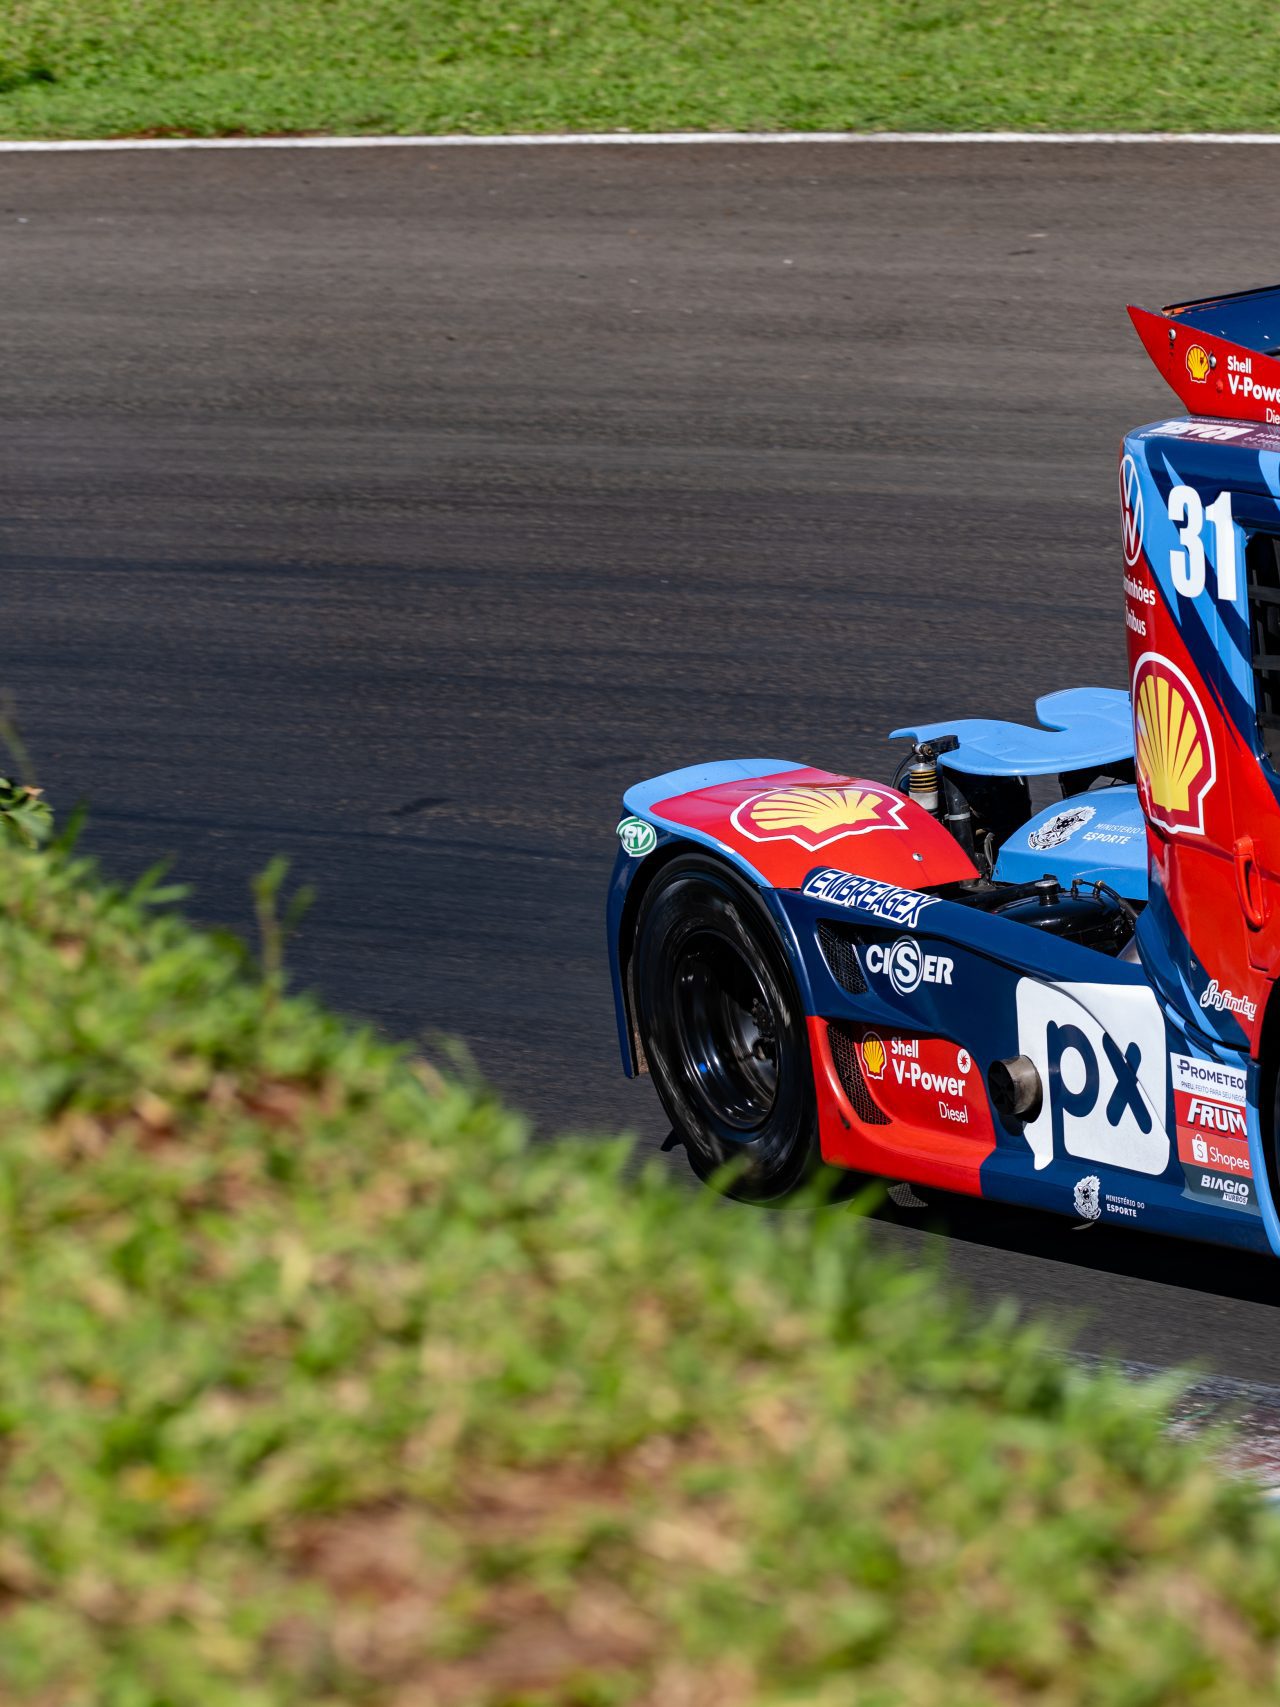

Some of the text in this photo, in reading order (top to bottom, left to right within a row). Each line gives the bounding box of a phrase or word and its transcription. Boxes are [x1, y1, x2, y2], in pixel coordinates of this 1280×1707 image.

[1227, 355, 1252, 374] Shell
[1168, 485, 1237, 601] 31
[1083, 831, 1131, 845] ESPORTE
[808, 869, 936, 928] EMBREAGEX
[866, 938, 953, 990] CISER
[891, 1037, 919, 1059] Shell
[892, 1062, 966, 1097] V-Power
[938, 1101, 968, 1123] Diesel
[1186, 1098, 1247, 1137] FRUM
[1209, 1146, 1250, 1171] Shopee
[1200, 1174, 1249, 1196] BIAGIO
[1105, 1194, 1145, 1209] MINISTÉRIO DO
[1106, 1204, 1137, 1217] ESPORTE
